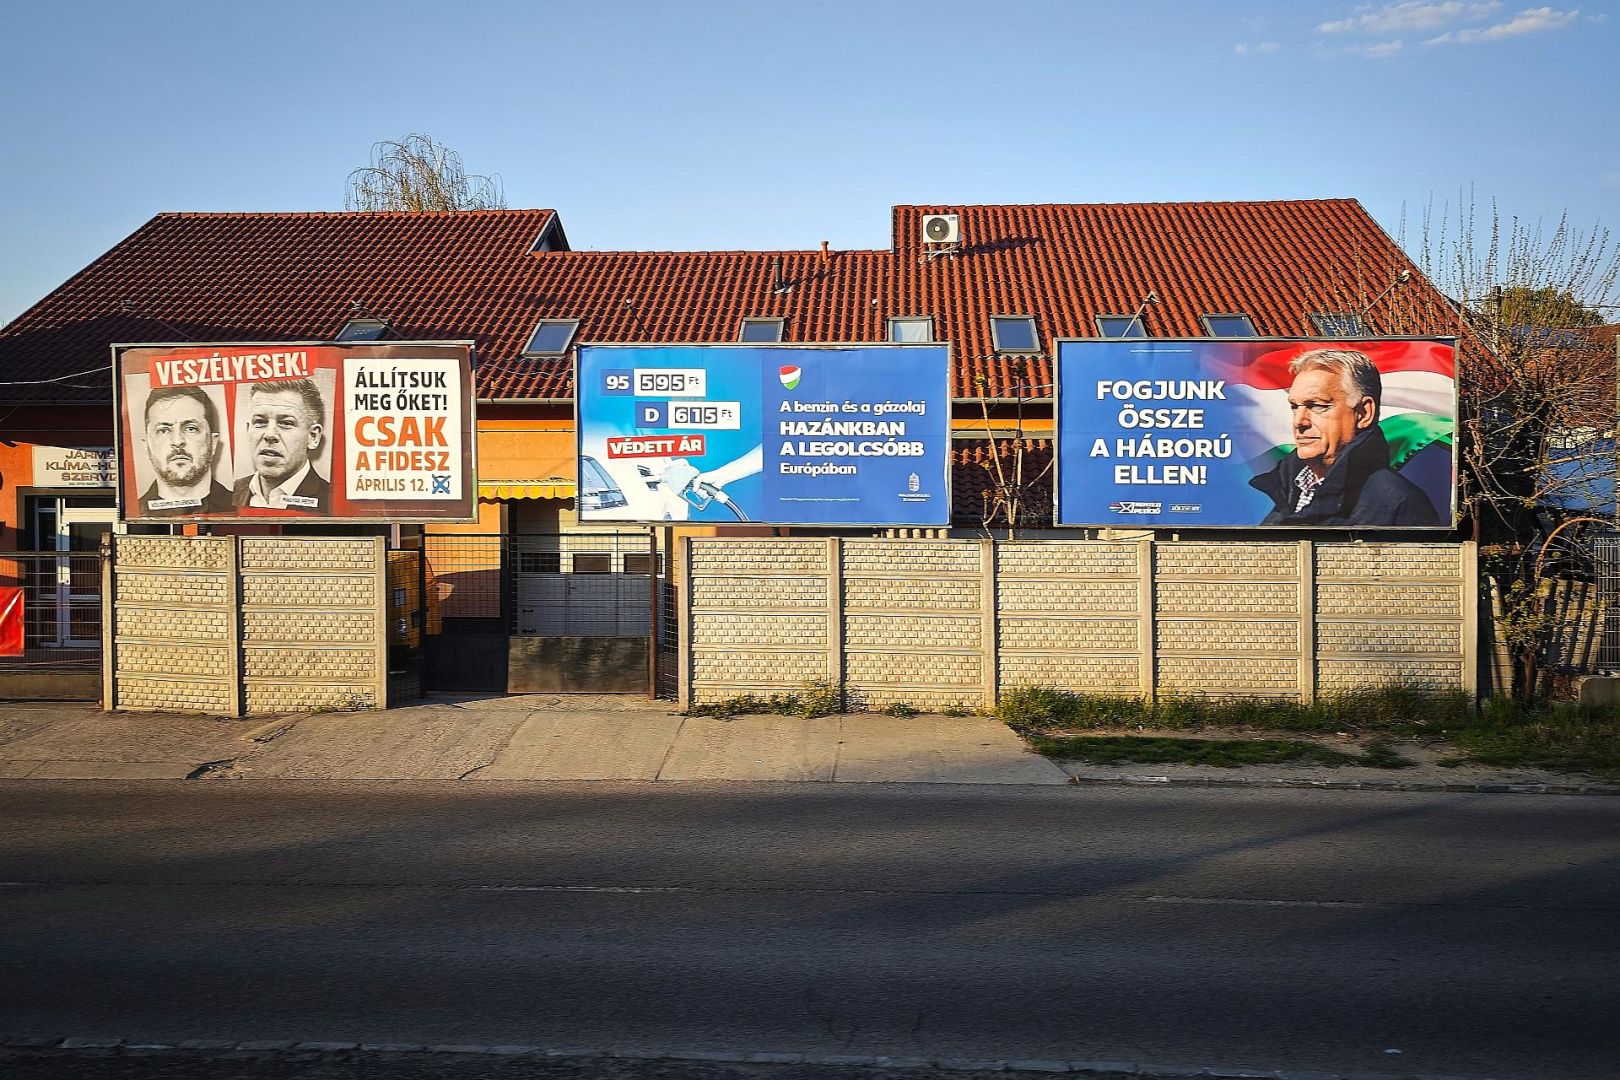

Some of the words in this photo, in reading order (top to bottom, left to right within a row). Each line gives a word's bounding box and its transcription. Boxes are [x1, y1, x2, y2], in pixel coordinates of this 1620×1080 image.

[155, 351, 308, 386] VESZÉLYESEK!
[355, 366, 446, 389] ÁLLÍTSUK
[606, 375, 630, 390] 95
[641, 374, 684, 391] 595
[689, 377, 699, 385] Ft
[1097, 380, 1226, 400] FOGJUNK
[355, 394, 391, 411] MEG
[396, 390, 448, 411] ŐKET!
[780, 401, 791, 413] A
[794, 401, 838, 413] benzin
[842, 401, 858, 413] és
[862, 404, 870, 413] a
[875, 401, 926, 416] gázolaj
[645, 409, 660, 422] D
[675, 407, 717, 423] 615
[722, 410, 732, 418] Ft
[1118, 404, 1204, 429] ÖSSZE
[355, 416, 449, 447] CSAK
[780, 418, 905, 436] HAZÁNKBAN
[610, 438, 675, 454] VÉDETT
[679, 437, 702, 452] ÁR
[780, 442, 795, 456] A
[799, 438, 925, 456] LEGOLCSÓBB
[1090, 438, 1110, 458] A
[1117, 433, 1231, 458] HÁBORÚ
[356, 451, 370, 471] A
[375, 451, 449, 471] FIDESZ
[780, 462, 857, 477] Európában
[356, 477, 405, 492] ÁPRILIS
[410, 478, 428, 492] 12.
[1114, 466, 1208, 485] ELLEN!
